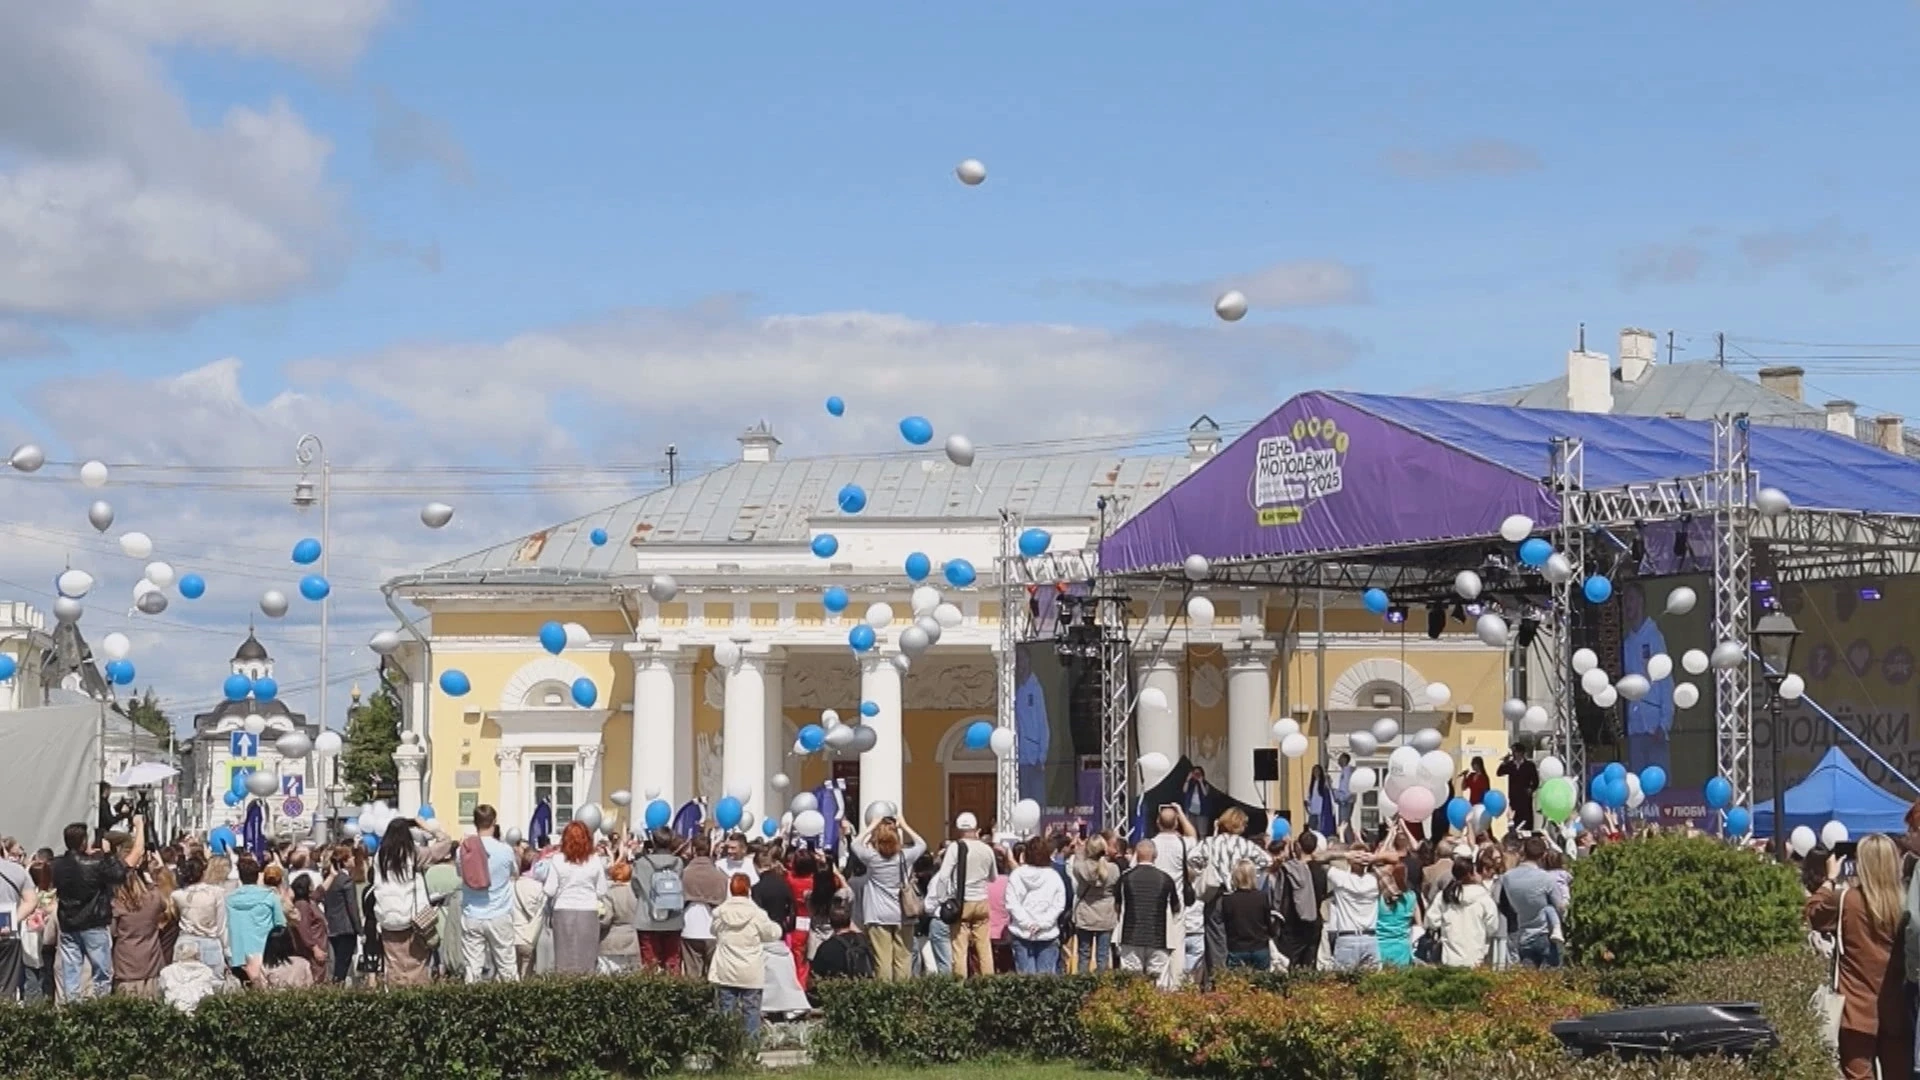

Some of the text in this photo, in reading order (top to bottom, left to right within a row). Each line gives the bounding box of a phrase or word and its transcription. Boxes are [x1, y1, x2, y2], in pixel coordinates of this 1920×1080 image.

[1260, 442, 1293, 459] ДЕНЬ
[1309, 472, 1340, 493] 2025
[1752, 707, 1910, 752] ОЛОДЁЖИ
[1672, 805, 1706, 817] ЛЮБИ
